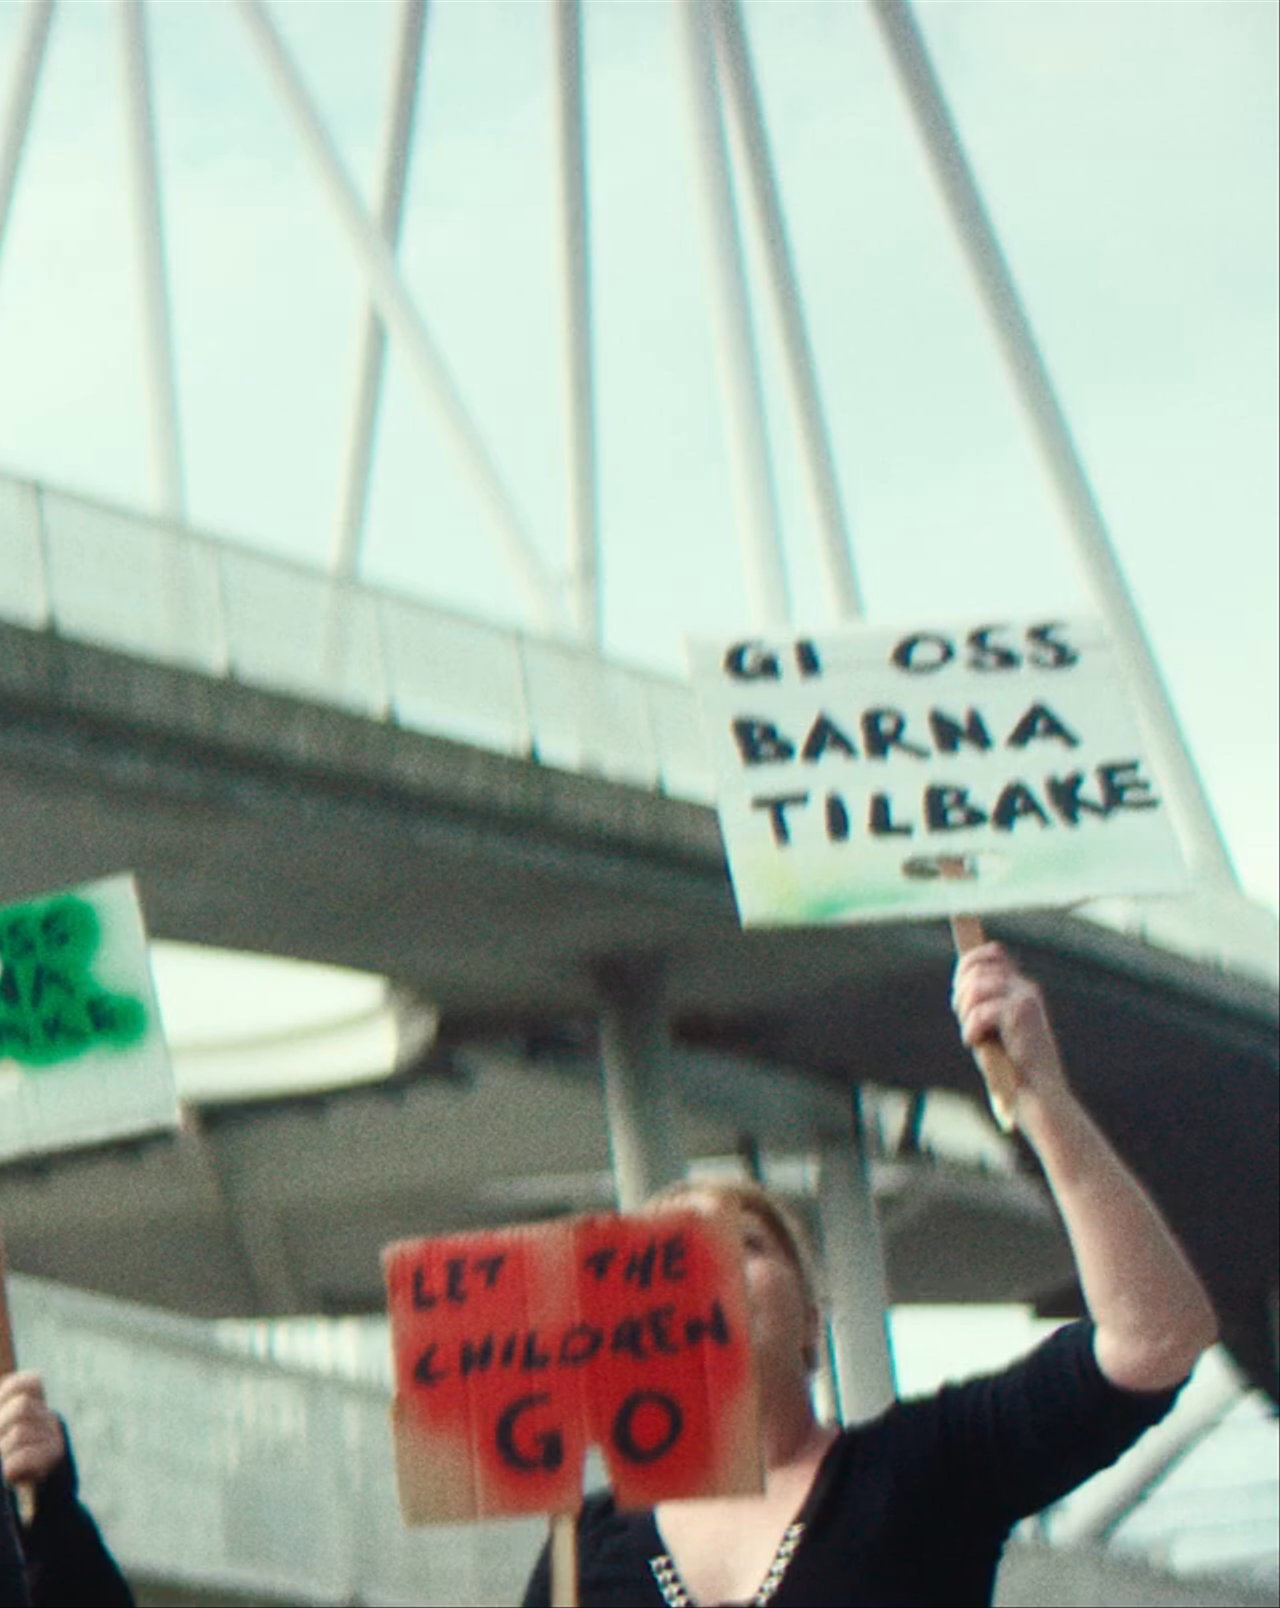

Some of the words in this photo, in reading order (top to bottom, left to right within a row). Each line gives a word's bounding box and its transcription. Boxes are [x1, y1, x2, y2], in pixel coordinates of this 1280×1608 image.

[723, 636, 824, 683] GI
[888, 621, 1080, 675] OSS
[731, 699, 1081, 767] BARNA
[750, 759, 1162, 848] TILBAKE
[410, 1253, 507, 1311] LET
[583, 1231, 690, 1289] THE
[413, 1299, 731, 1388] CHILDREN
[495, 1387, 684, 1474] GO
